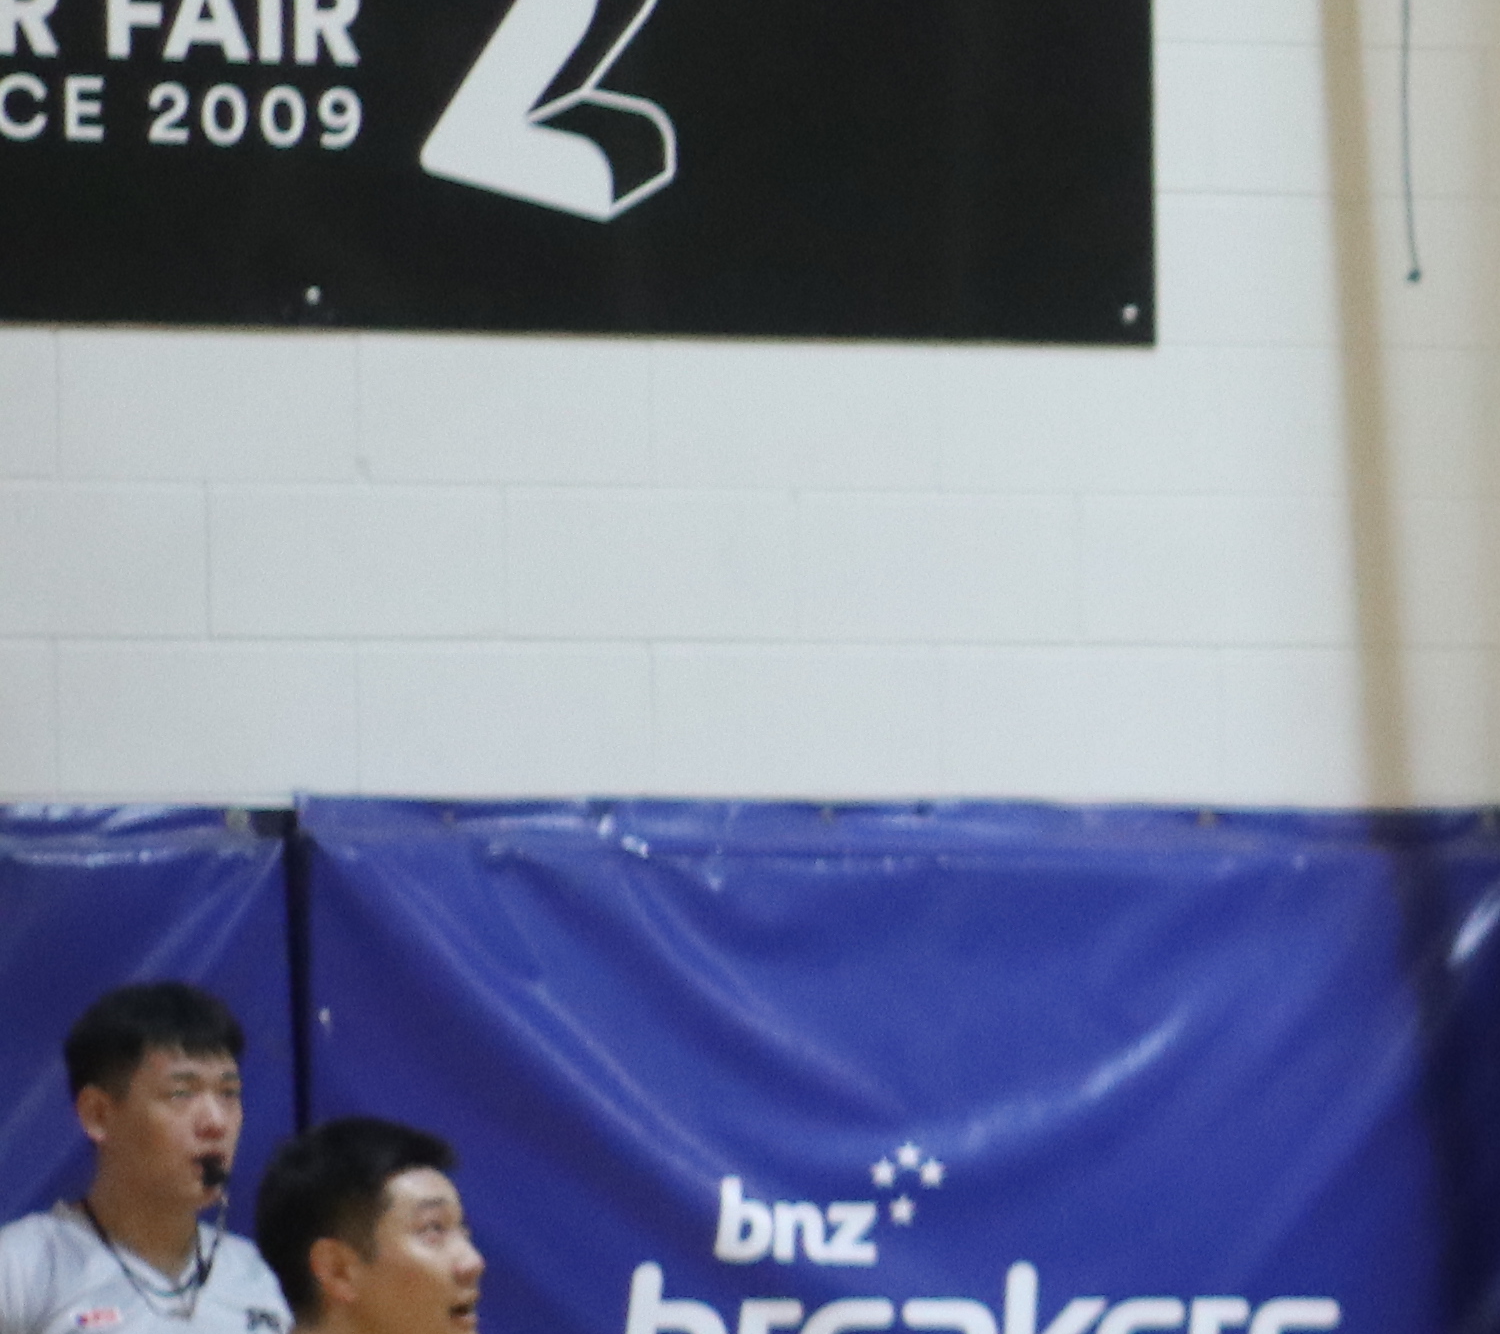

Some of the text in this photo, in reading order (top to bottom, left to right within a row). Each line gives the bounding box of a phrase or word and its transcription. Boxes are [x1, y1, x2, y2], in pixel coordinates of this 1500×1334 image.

[0, 71, 362, 149] CE 2009
[714, 1175, 880, 1265] bnz
